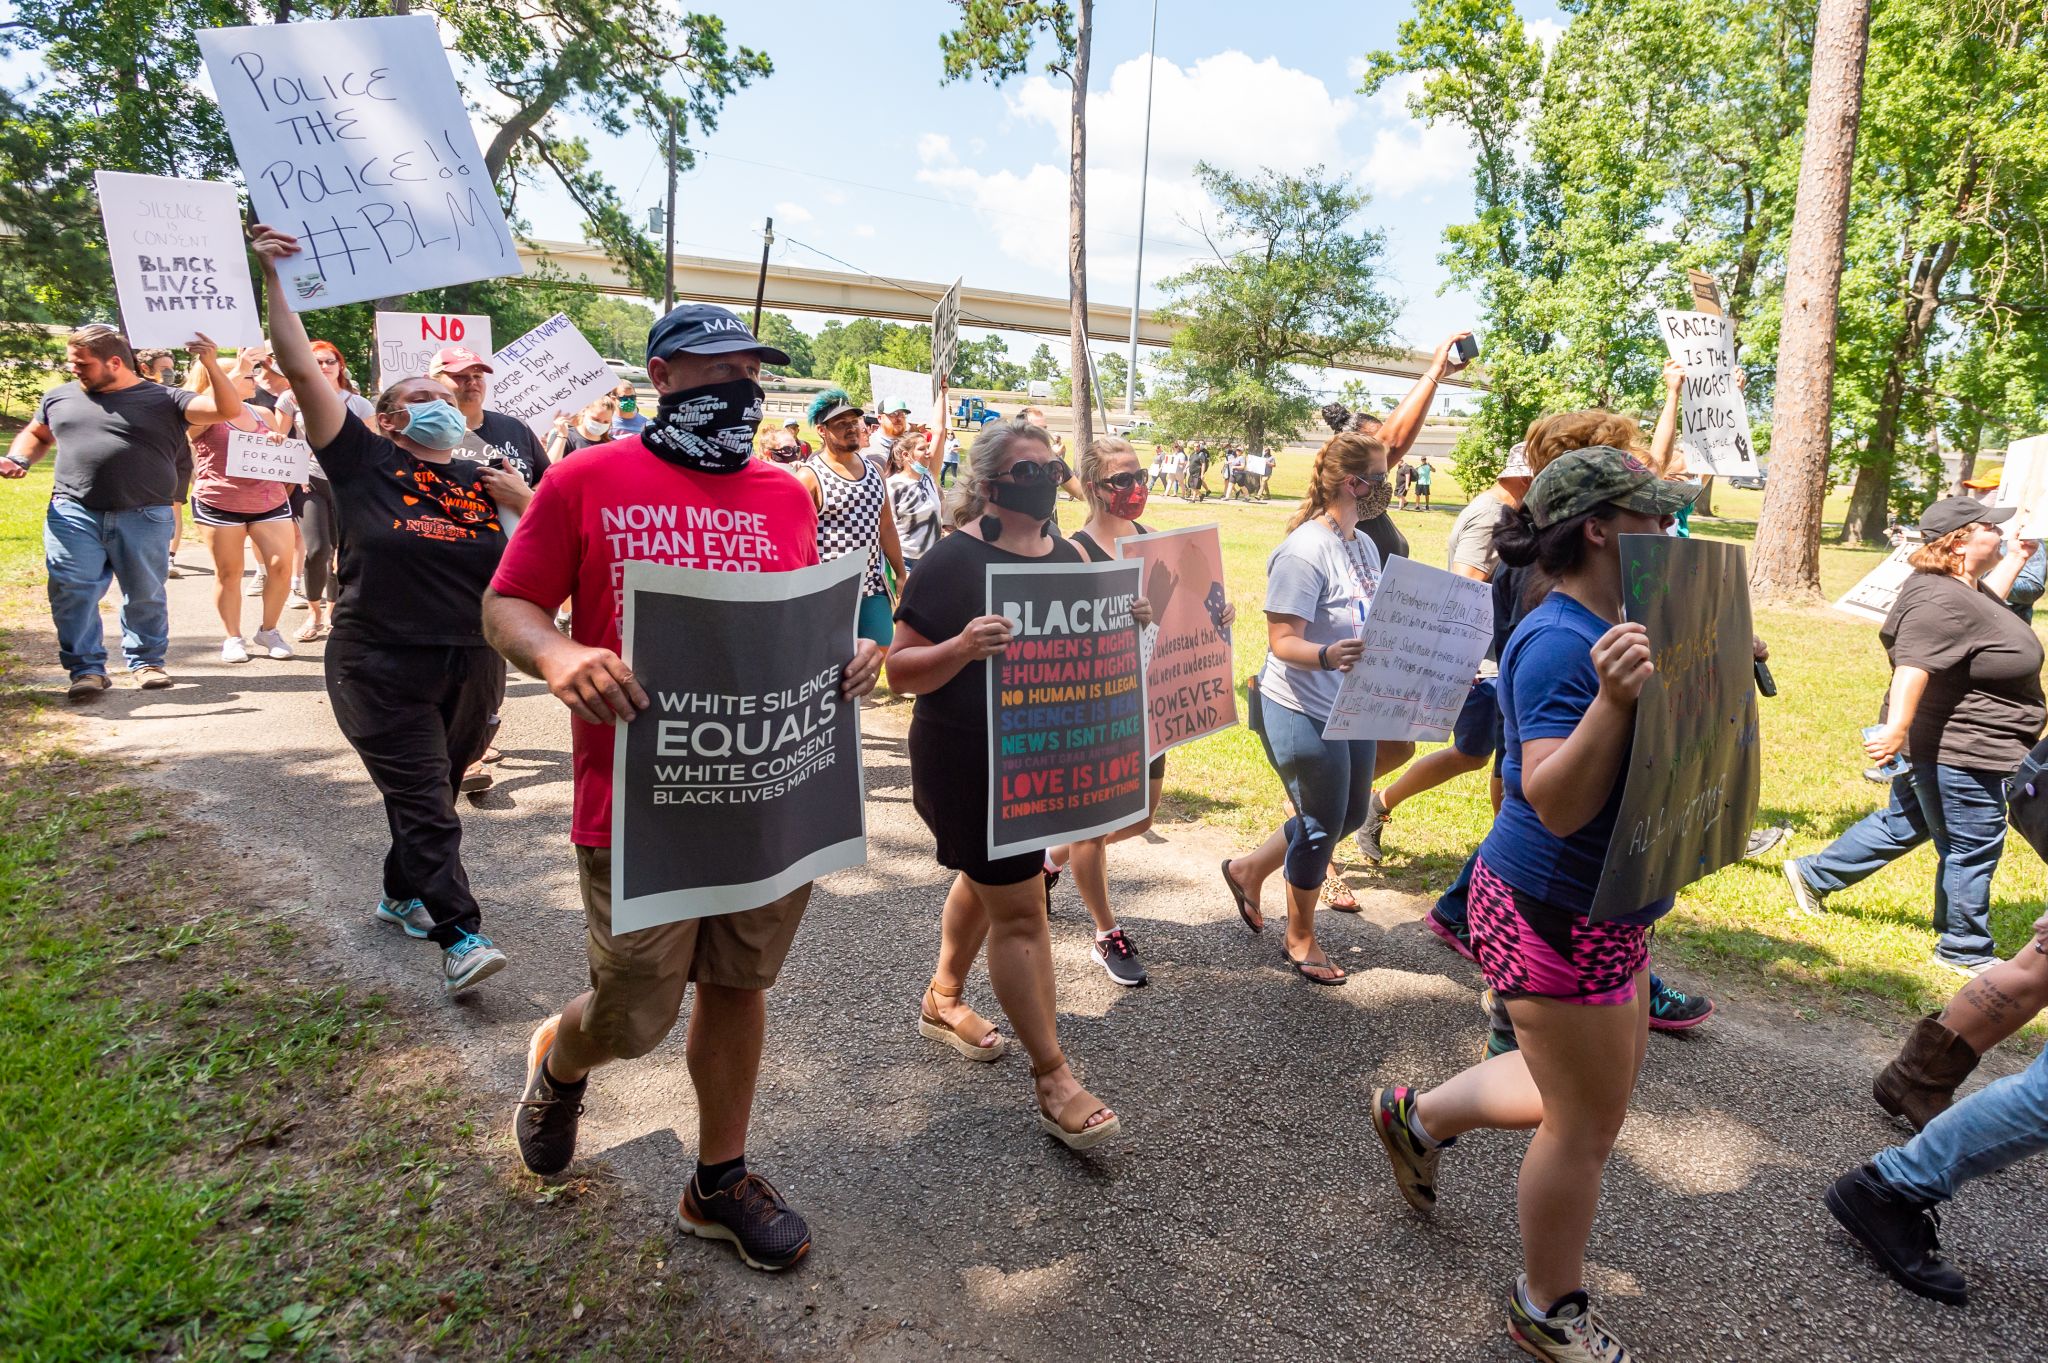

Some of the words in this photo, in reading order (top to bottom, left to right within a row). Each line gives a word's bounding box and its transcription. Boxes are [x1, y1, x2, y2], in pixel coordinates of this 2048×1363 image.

[231, 52, 397, 111] POLICE
[275, 109, 367, 145] THE
[261, 130, 470, 209] POLICE!!
[137, 200, 207, 222] SILENCE
[133, 230, 209, 248] CONSENT
[297, 187, 504, 282] #BLM
[138, 255, 217, 273] BLACK
[141, 275, 218, 295] LIVES
[145, 296, 237, 312] MATTER
[421, 315, 465, 341] NO
[493, 334, 536, 366] THEIR
[536, 314, 570, 341] NAMES
[1666, 316, 1728, 341] RACISM
[519, 350, 554, 373] Floyd
[536, 362, 571, 383] Taylor
[1684, 349, 1702, 366] IS
[1707, 347, 1728, 367] THE
[539, 387, 572, 407] Lives
[568, 366, 605, 390] Matter
[1686, 373, 1732, 401] WORST
[669, 412, 714, 425] Phillips
[678, 401, 728, 413] Chevron
[1685, 407, 1736, 435] VIRUS
[243, 451, 268, 460] FOR
[273, 455, 296, 464] ALL
[601, 505, 677, 532] NOW
[685, 506, 769, 536] MORE
[606, 531, 695, 559] THAN
[703, 532, 779, 561] EVER:
[1003, 598, 1109, 637] BLACK
[1005, 637, 1093, 661] WOMEN'S
[1097, 630, 1136, 653] RIGHTS
[1002, 664, 1012, 685] ARE
[1014, 660, 1090, 685] HUMAN
[1094, 652, 1137, 680] RIGHTS
[658, 691, 756, 715] WHITE
[762, 664, 839, 712] SILENCE
[1002, 690, 1024, 707] NO
[1028, 684, 1086, 704] HUMAN
[1089, 683, 1101, 699] IS
[1105, 675, 1138, 696] ILLEGAL
[656, 690, 836, 758] EQUALS
[1002, 705, 1085, 732] SCIENCE
[1091, 703, 1105, 722] IS
[1110, 694, 1137, 717] REAL
[1154, 722, 1161, 744] I
[1165, 705, 1222, 741] STAND.
[1002, 731, 1060, 756] NEWS
[1066, 724, 1108, 749] ISN'T
[1111, 715, 1140, 741] FAKE
[654, 764, 745, 782] WHITE
[752, 727, 836, 779] CONSENT
[653, 790, 724, 805] BLACK
[729, 783, 785, 804] LIVES
[787, 752, 836, 792] MATTER
[1002, 768, 1065, 801] LOVE
[1072, 764, 1093, 789] IS
[1100, 751, 1140, 785] LOVE
[1002, 796, 1065, 820] KINDNESS
[1068, 795, 1080, 809] IS
[1083, 778, 1140, 806] EVERYTHING
